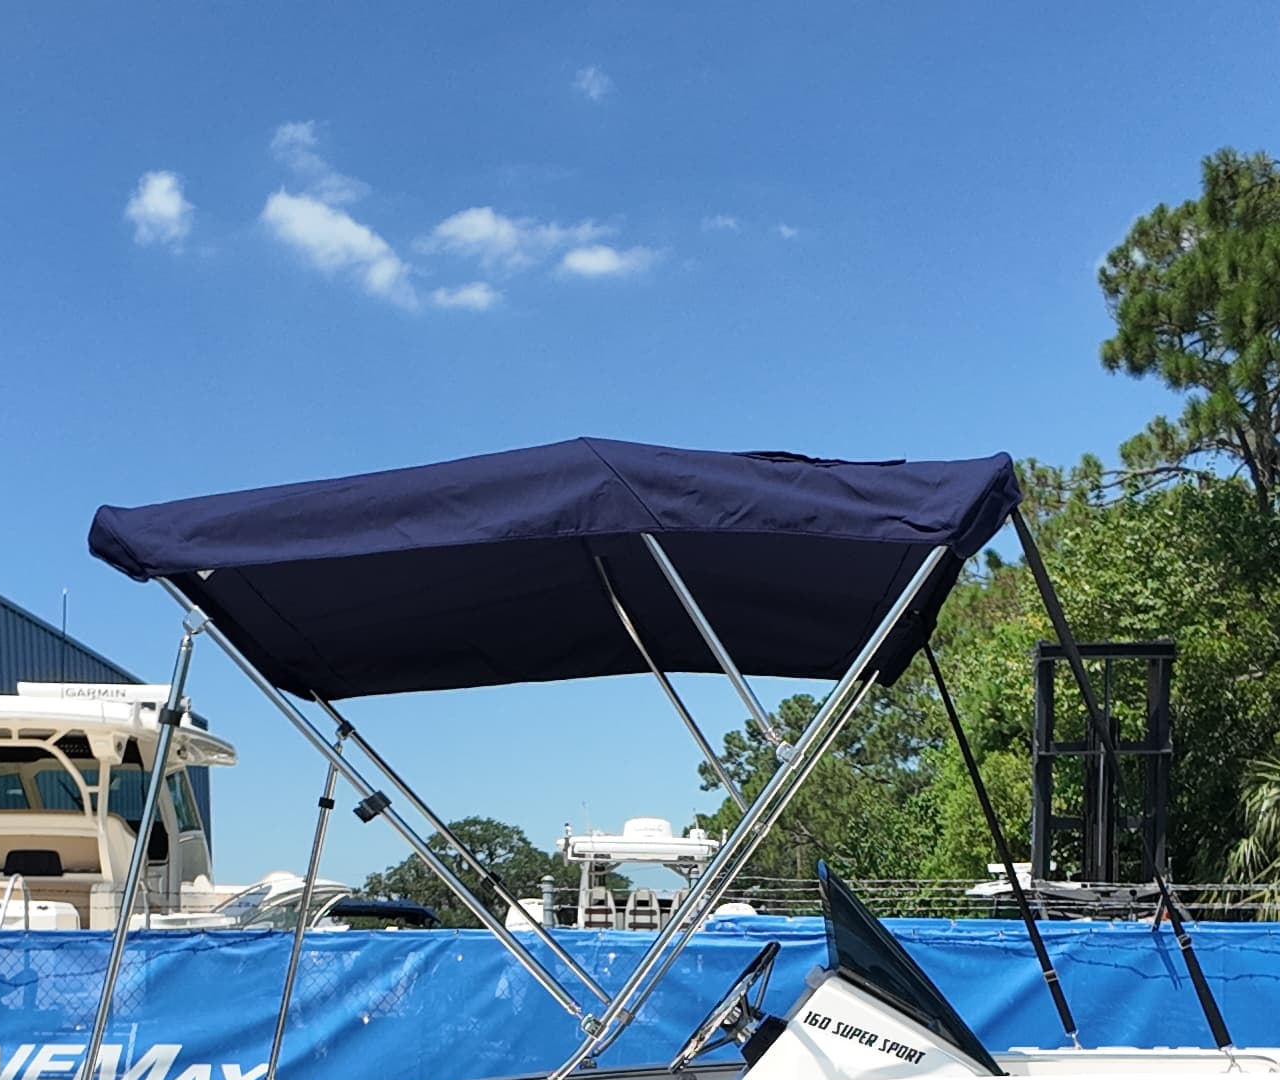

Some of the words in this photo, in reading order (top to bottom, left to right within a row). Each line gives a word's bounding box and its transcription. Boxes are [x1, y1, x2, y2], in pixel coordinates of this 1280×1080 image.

[65, 687, 127, 699] GARMIN
[803, 1011, 832, 1030] 160
[832, 1021, 878, 1048] SUPER
[878, 1038, 926, 1065] SPORT
